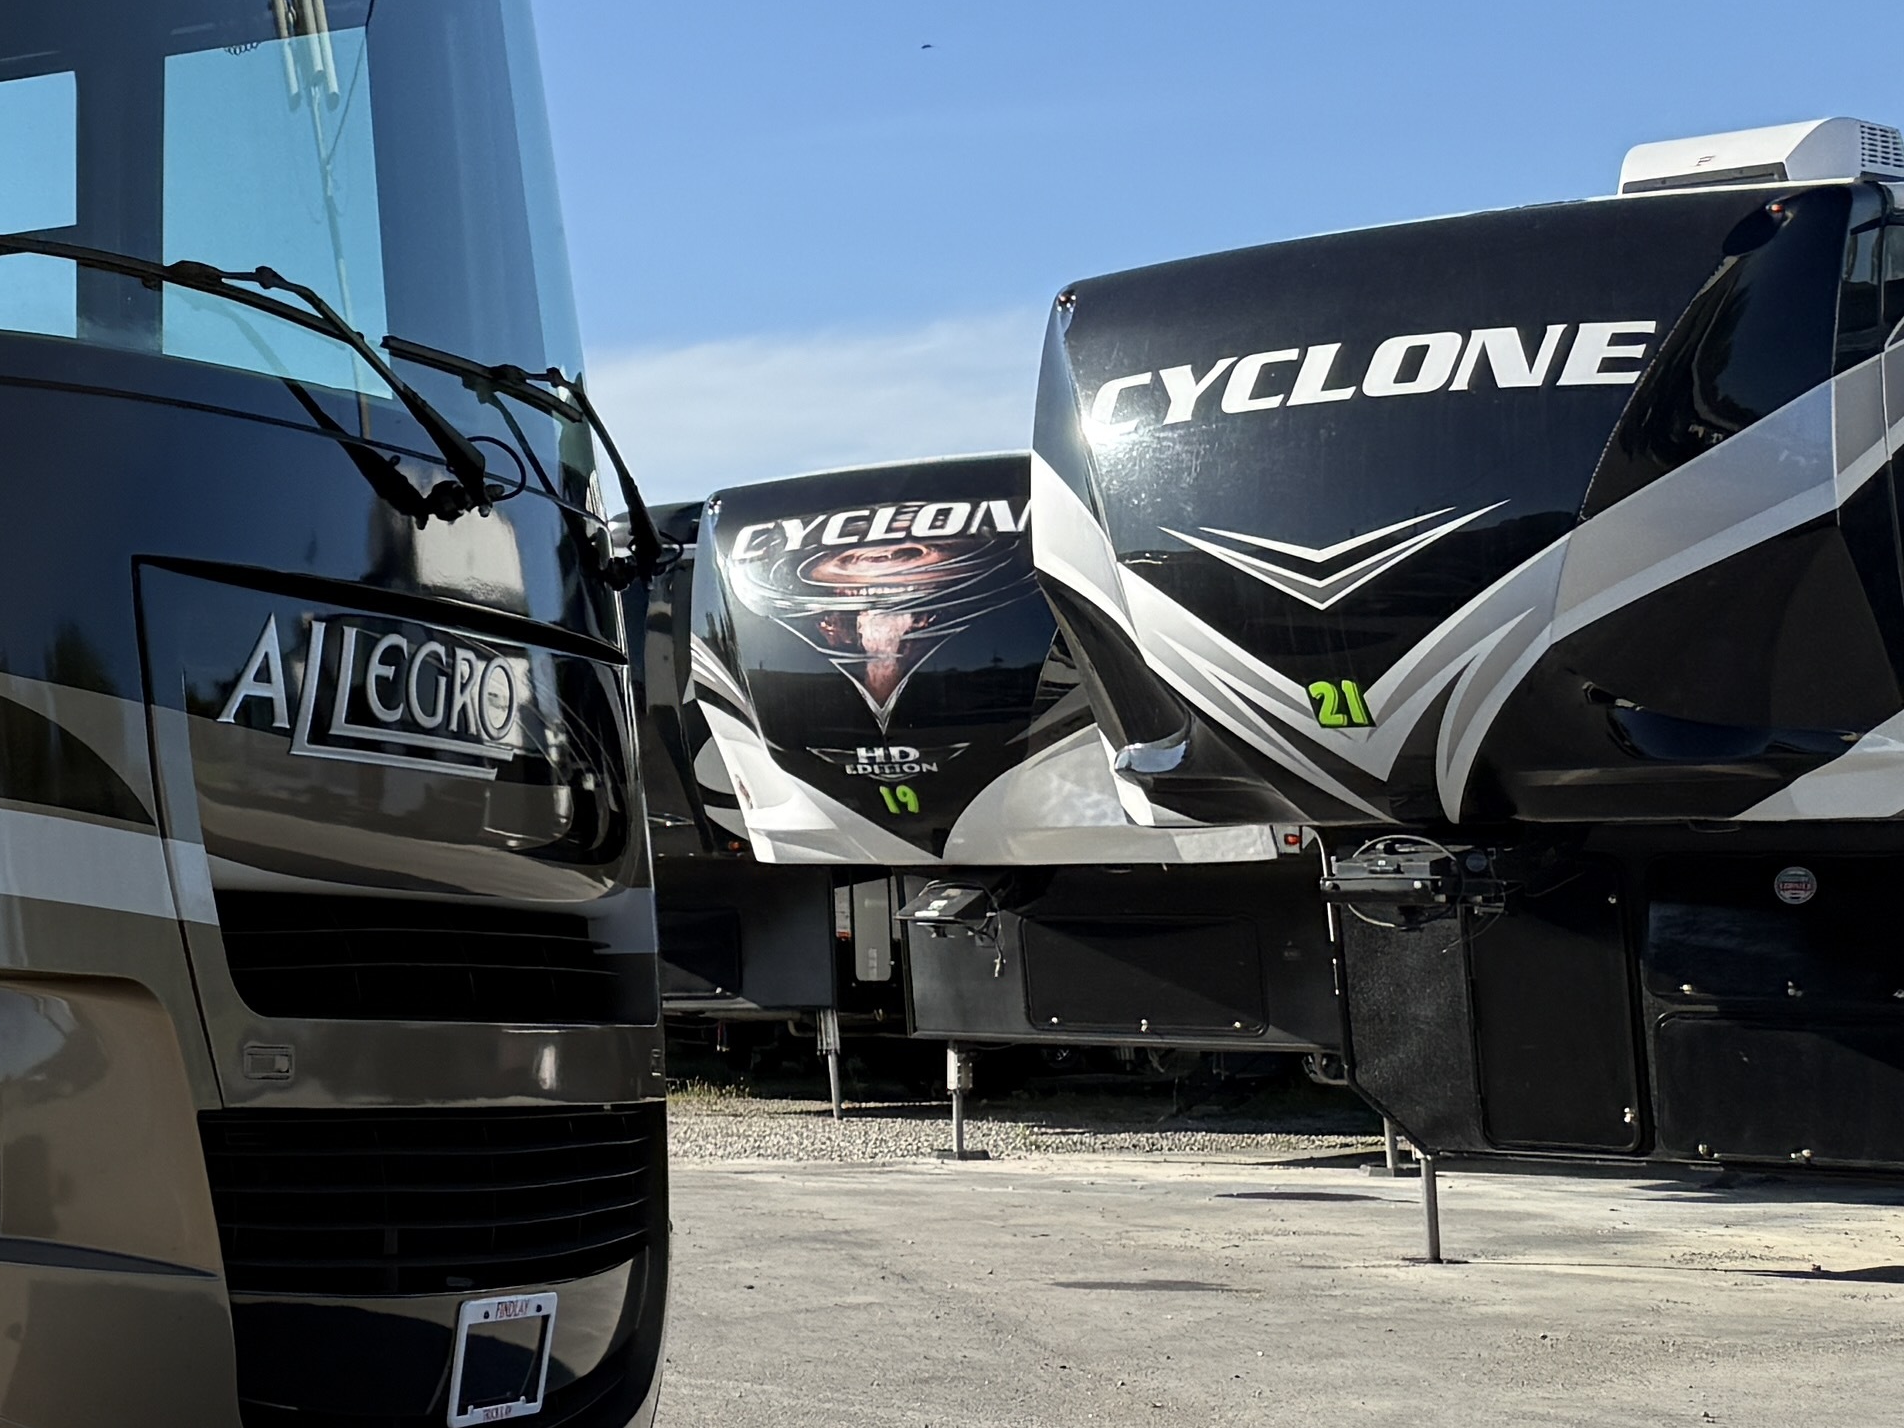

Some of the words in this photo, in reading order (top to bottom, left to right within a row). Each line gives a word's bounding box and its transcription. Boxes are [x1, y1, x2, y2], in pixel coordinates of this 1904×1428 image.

[1089, 320, 1657, 437] CYCLONE
[731, 498, 1031, 560] CYCLON
[215, 611, 518, 780] ALLEGRO
[1308, 679, 1369, 727] 21
[845, 762, 939, 775] EDITION
[856, 746, 920, 763] HD
[879, 784, 920, 814] 19
